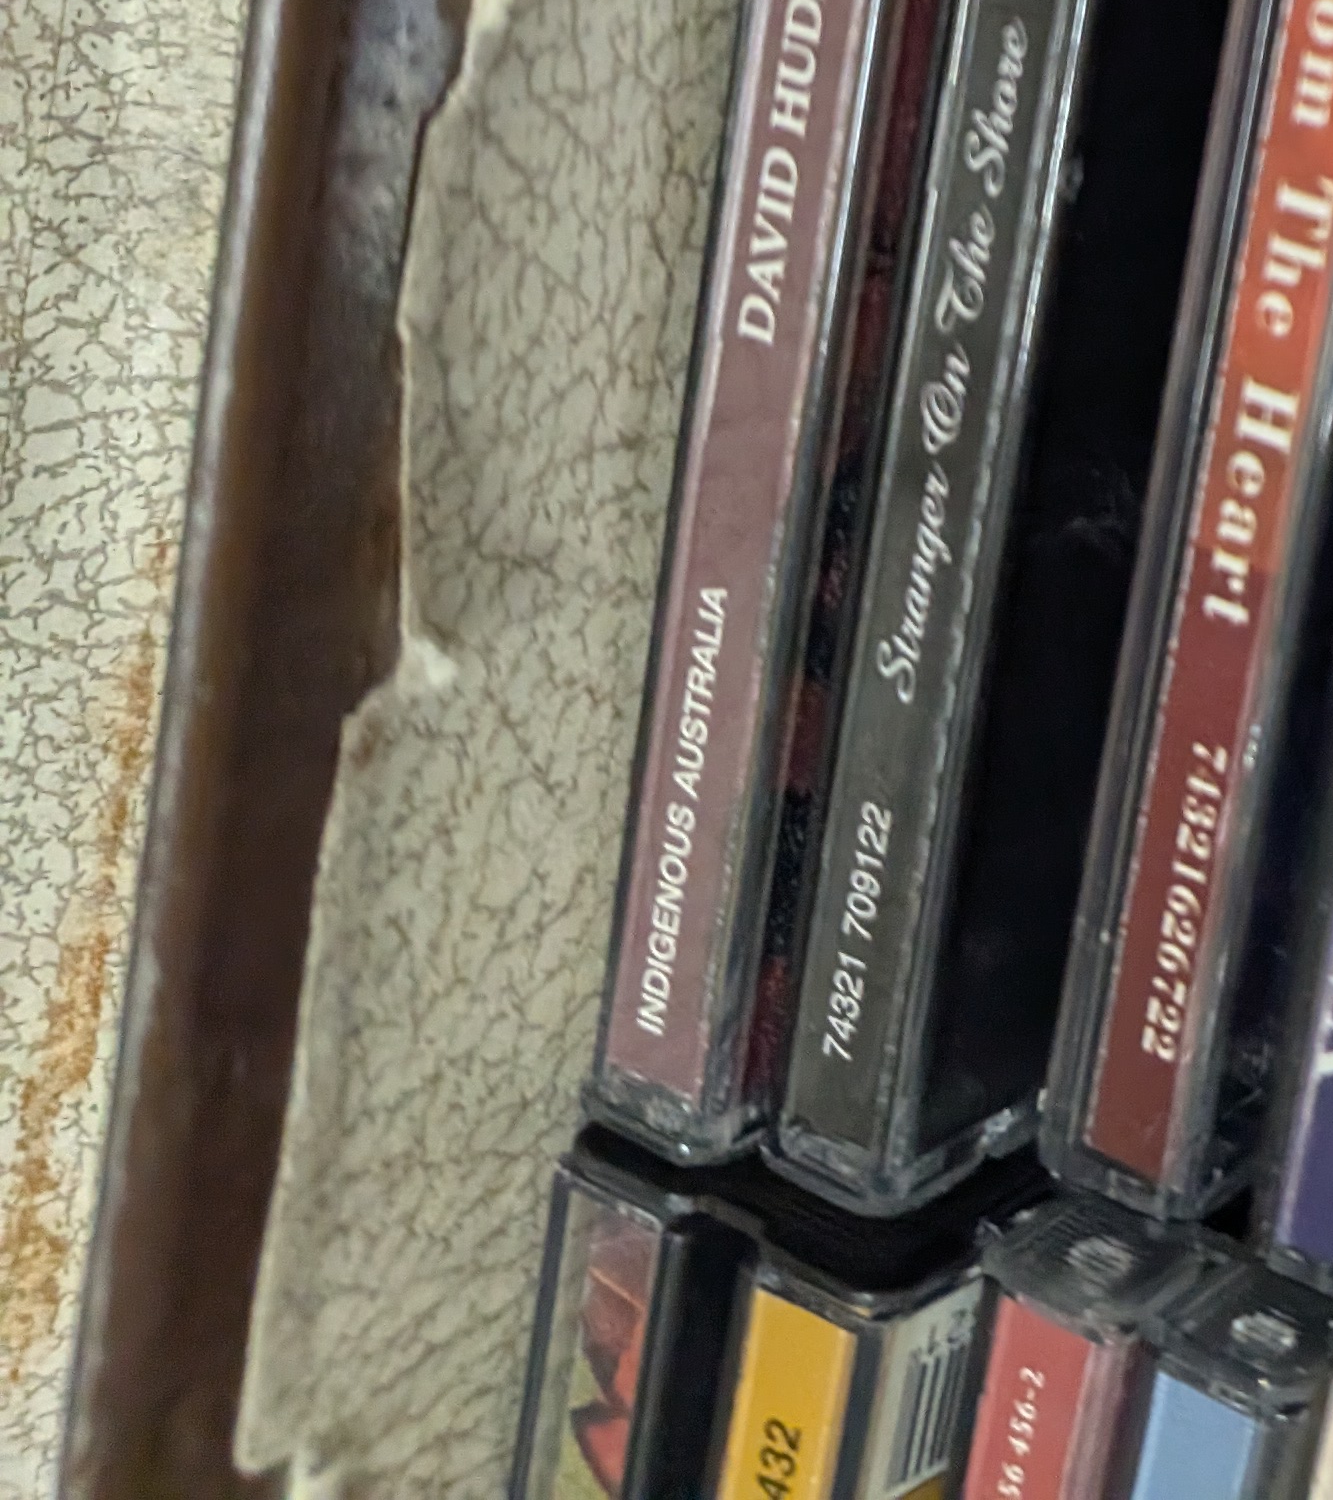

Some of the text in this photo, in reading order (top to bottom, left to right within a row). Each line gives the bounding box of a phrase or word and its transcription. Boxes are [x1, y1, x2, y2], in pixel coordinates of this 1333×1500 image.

[738, 148, 799, 346] DAVID
[878, 15, 1028, 705] Stranger On The Shore
[1203, 375, 1300, 629] Heart
[635, 586, 728, 1038] INDIGENOUS AUSTRALIA
[822, 801, 893, 1063] 74321 709122
[1140, 740, 1229, 1064] 74321626722
[1006, 1366, 1046, 1455] 456-2
